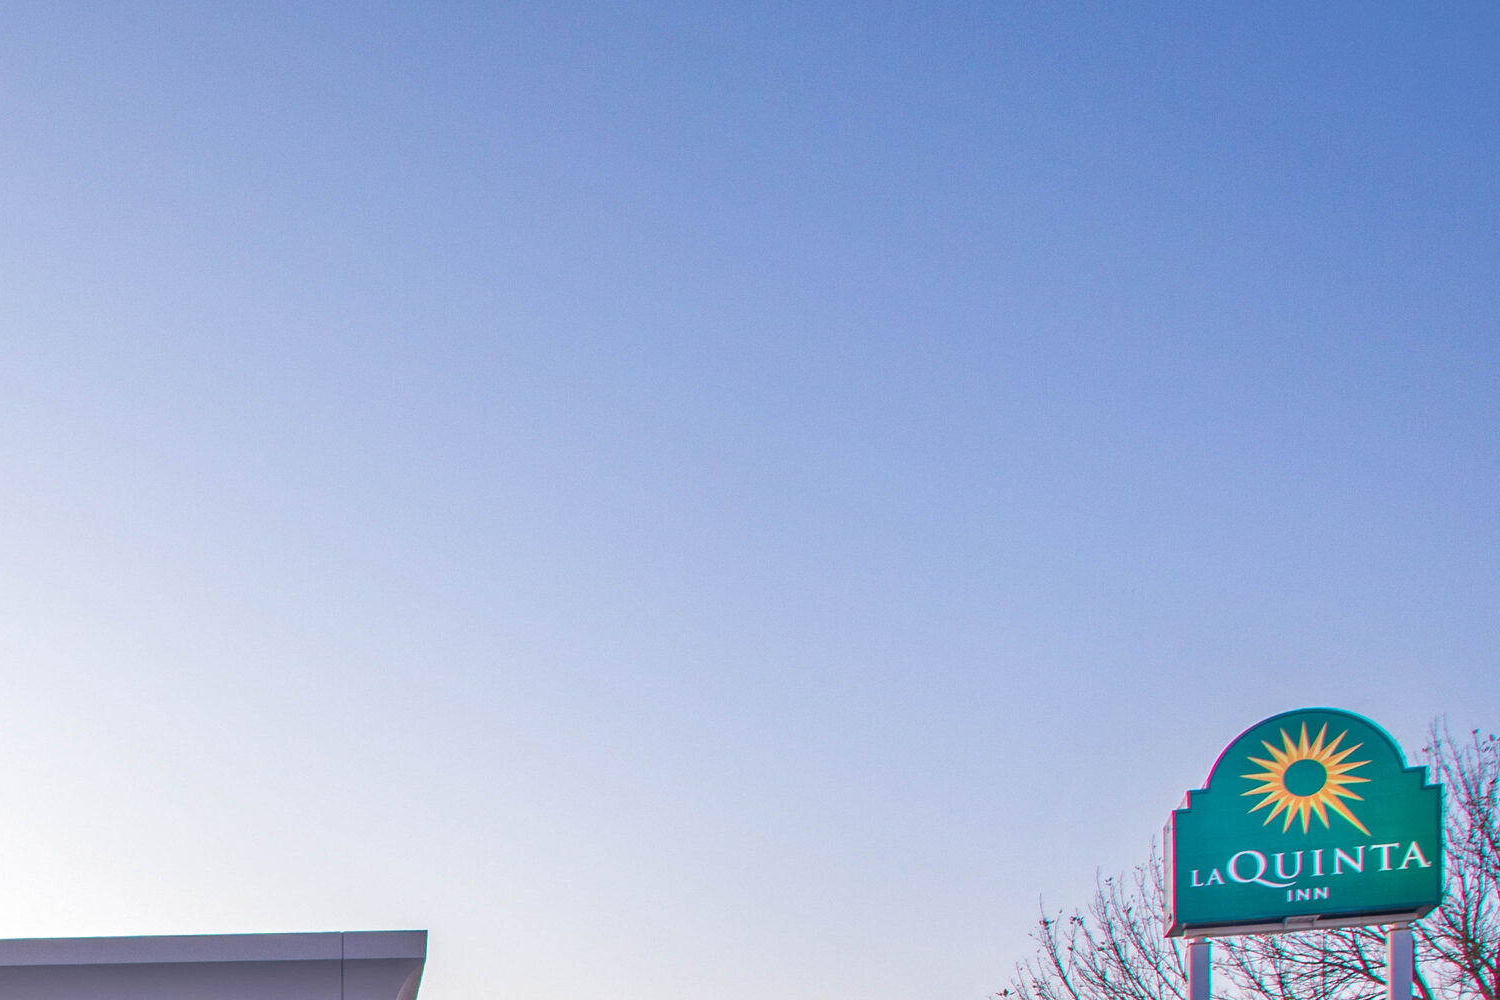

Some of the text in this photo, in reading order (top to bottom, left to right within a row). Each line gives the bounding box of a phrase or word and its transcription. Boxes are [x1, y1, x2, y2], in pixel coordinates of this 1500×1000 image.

[1190, 841, 1432, 888] LA QUINTA
[1286, 887, 1329, 902] INN
